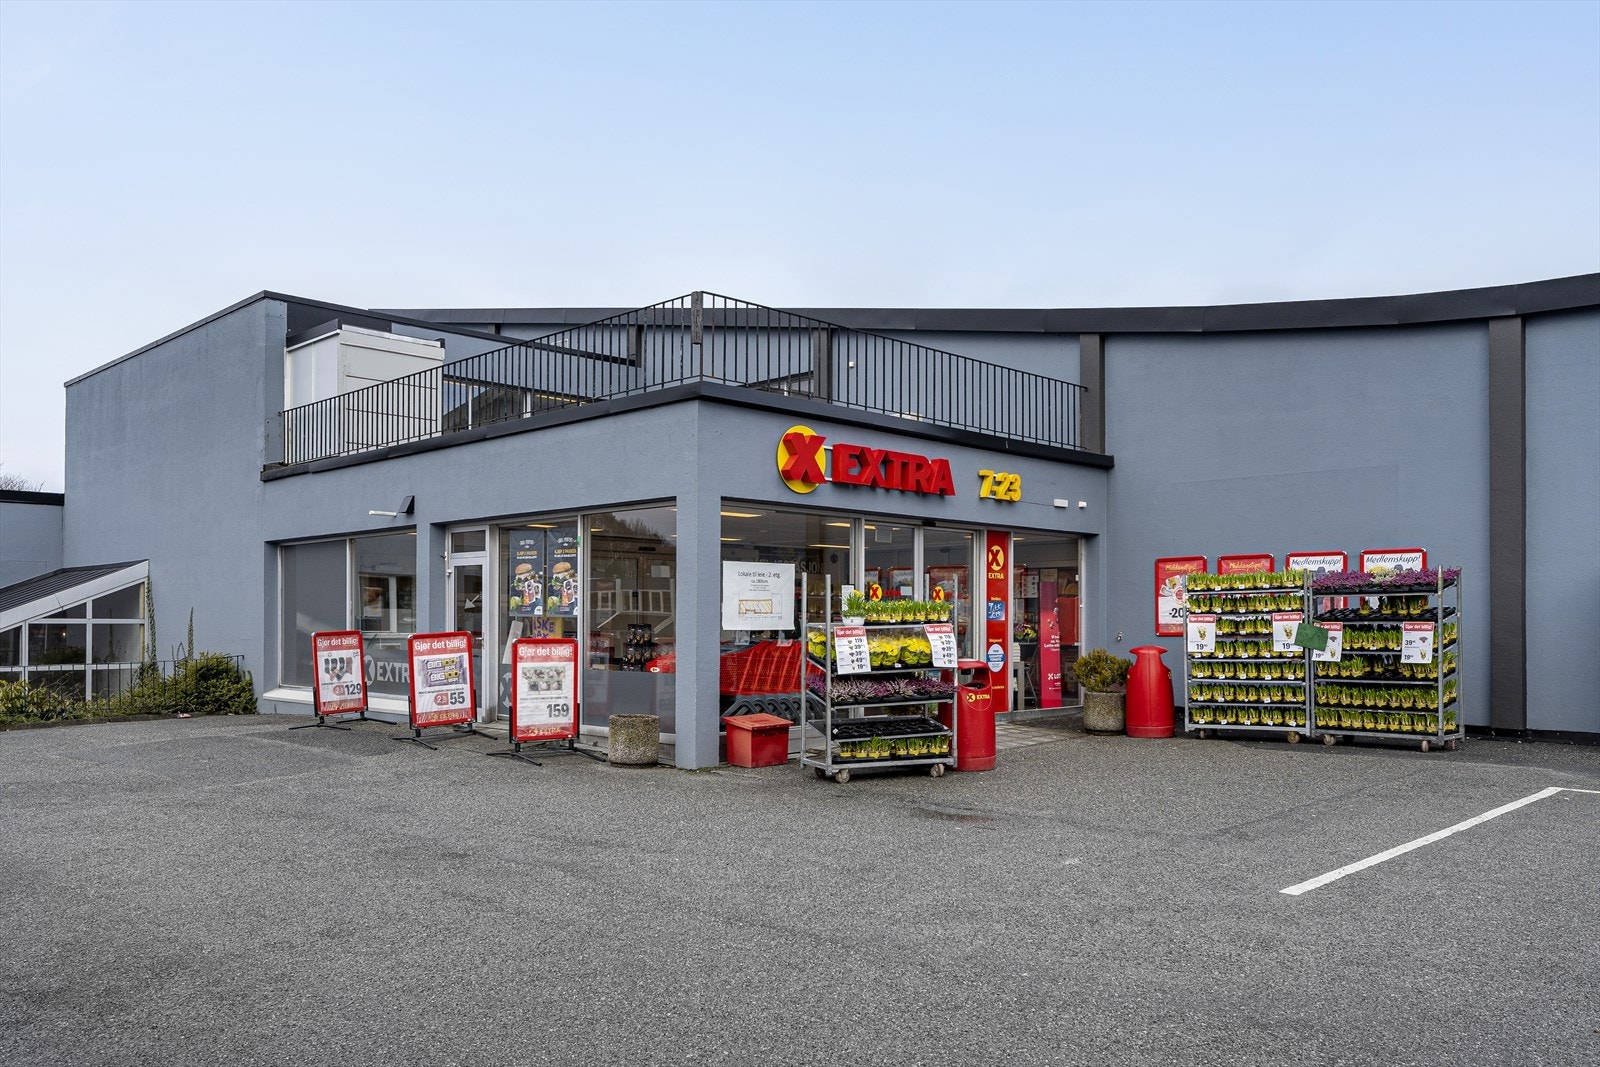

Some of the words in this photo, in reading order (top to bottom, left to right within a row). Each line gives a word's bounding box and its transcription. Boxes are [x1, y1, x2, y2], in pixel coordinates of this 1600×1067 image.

[781, 432, 827, 484] X
[832, 444, 956, 496] EXTRA
[978, 470, 1022, 502] 7-23
[988, 550, 1002, 567] X
[1292, 558, 1342, 566] Medlemskupp!
[1366, 554, 1421, 564] Medlemskupp!
[870, 587, 880, 599] X
[934, 589, 942, 600] X
[317, 639, 330, 648] Gjør
[342, 637, 359, 646] billig!
[415, 642, 430, 652] Gjør
[432, 640, 445, 649] det
[446, 638, 466, 649] billig!
[519, 647, 535, 658] Gjør
[537, 647, 550, 655] det
[552, 646, 573, 658] billig!
[377, 662, 410, 683] EXTR
[345, 683, 362, 695] 129
[450, 692, 465, 705] 55
[547, 703, 570, 718] 159
